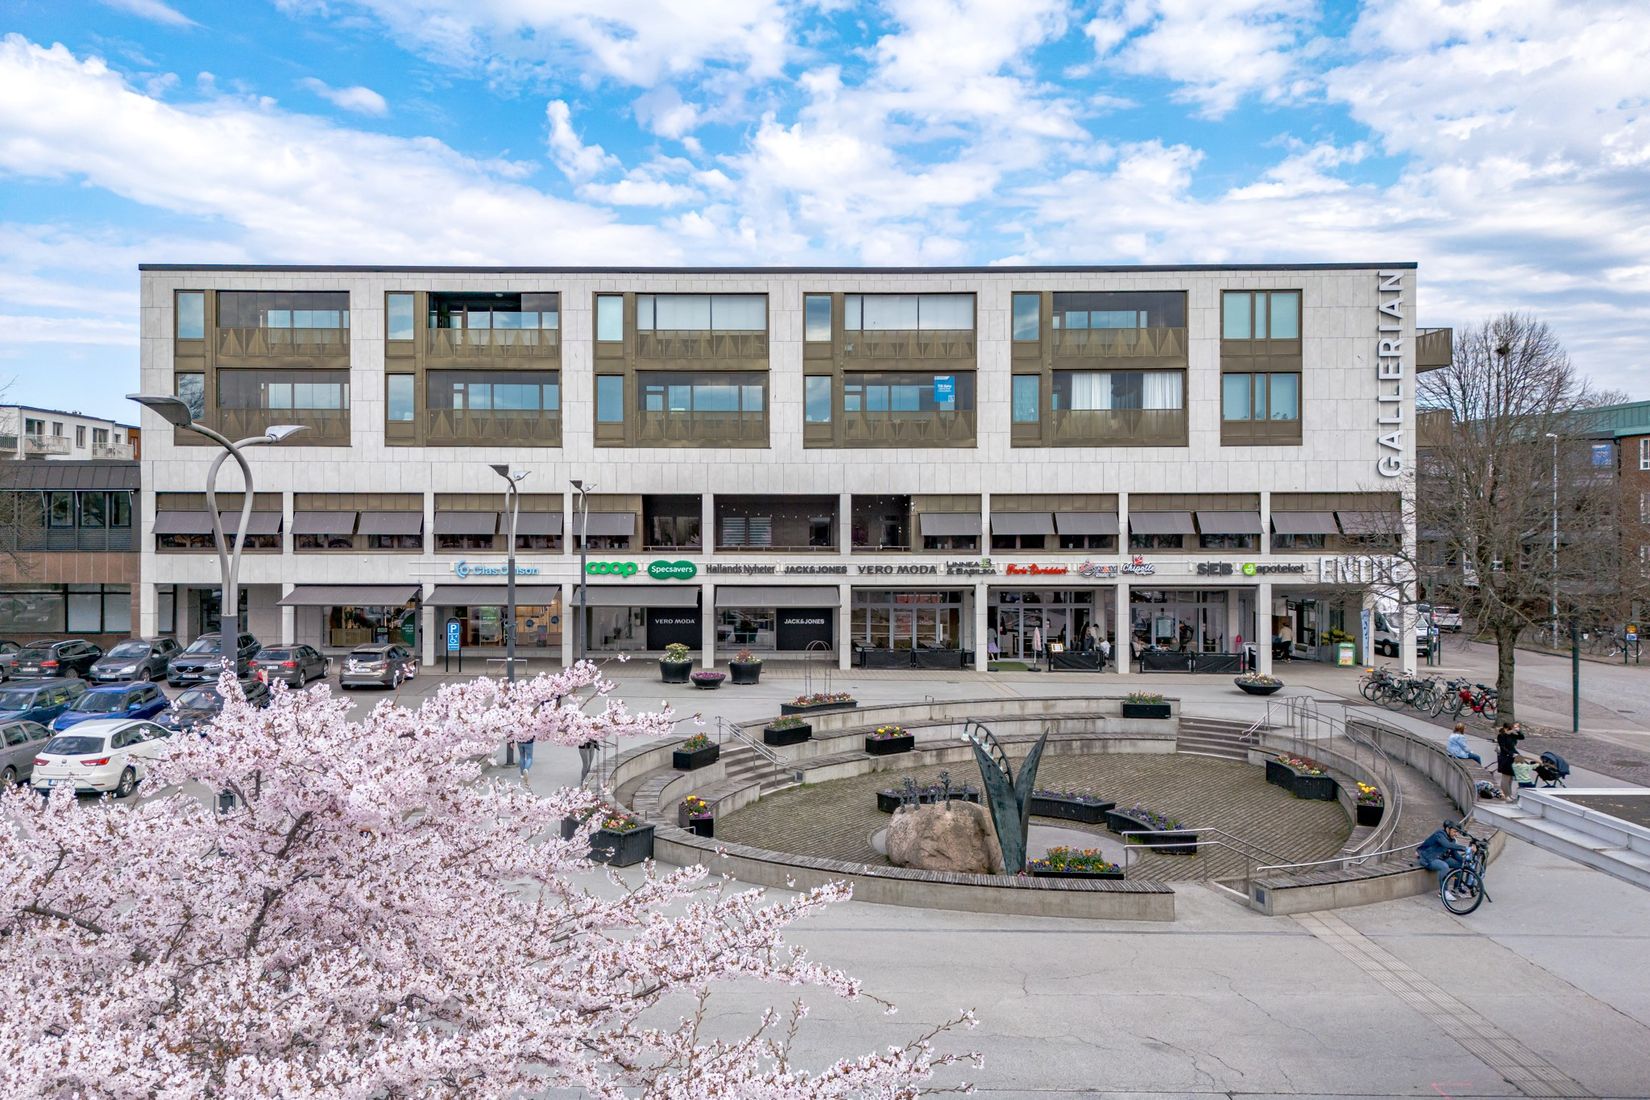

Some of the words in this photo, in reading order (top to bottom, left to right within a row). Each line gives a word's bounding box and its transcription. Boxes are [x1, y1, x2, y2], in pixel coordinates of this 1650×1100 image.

[1377, 271, 1404, 478] GALLERIAN
[473, 564, 497, 576] Clas
[500, 564, 539, 576] Olson
[585, 562, 638, 577] coop
[651, 565, 693, 575] Specsavers
[706, 564, 742, 574] Hallands
[743, 564, 775, 575] Nyheter
[784, 566, 848, 574] JACK&JONES
[857, 565, 893, 575] VERO
[896, 565, 937, 575] MODA
[1197, 562, 1233, 576] SEB
[1256, 563, 1305, 575] apoteket
[450, 624, 457, 633] P
